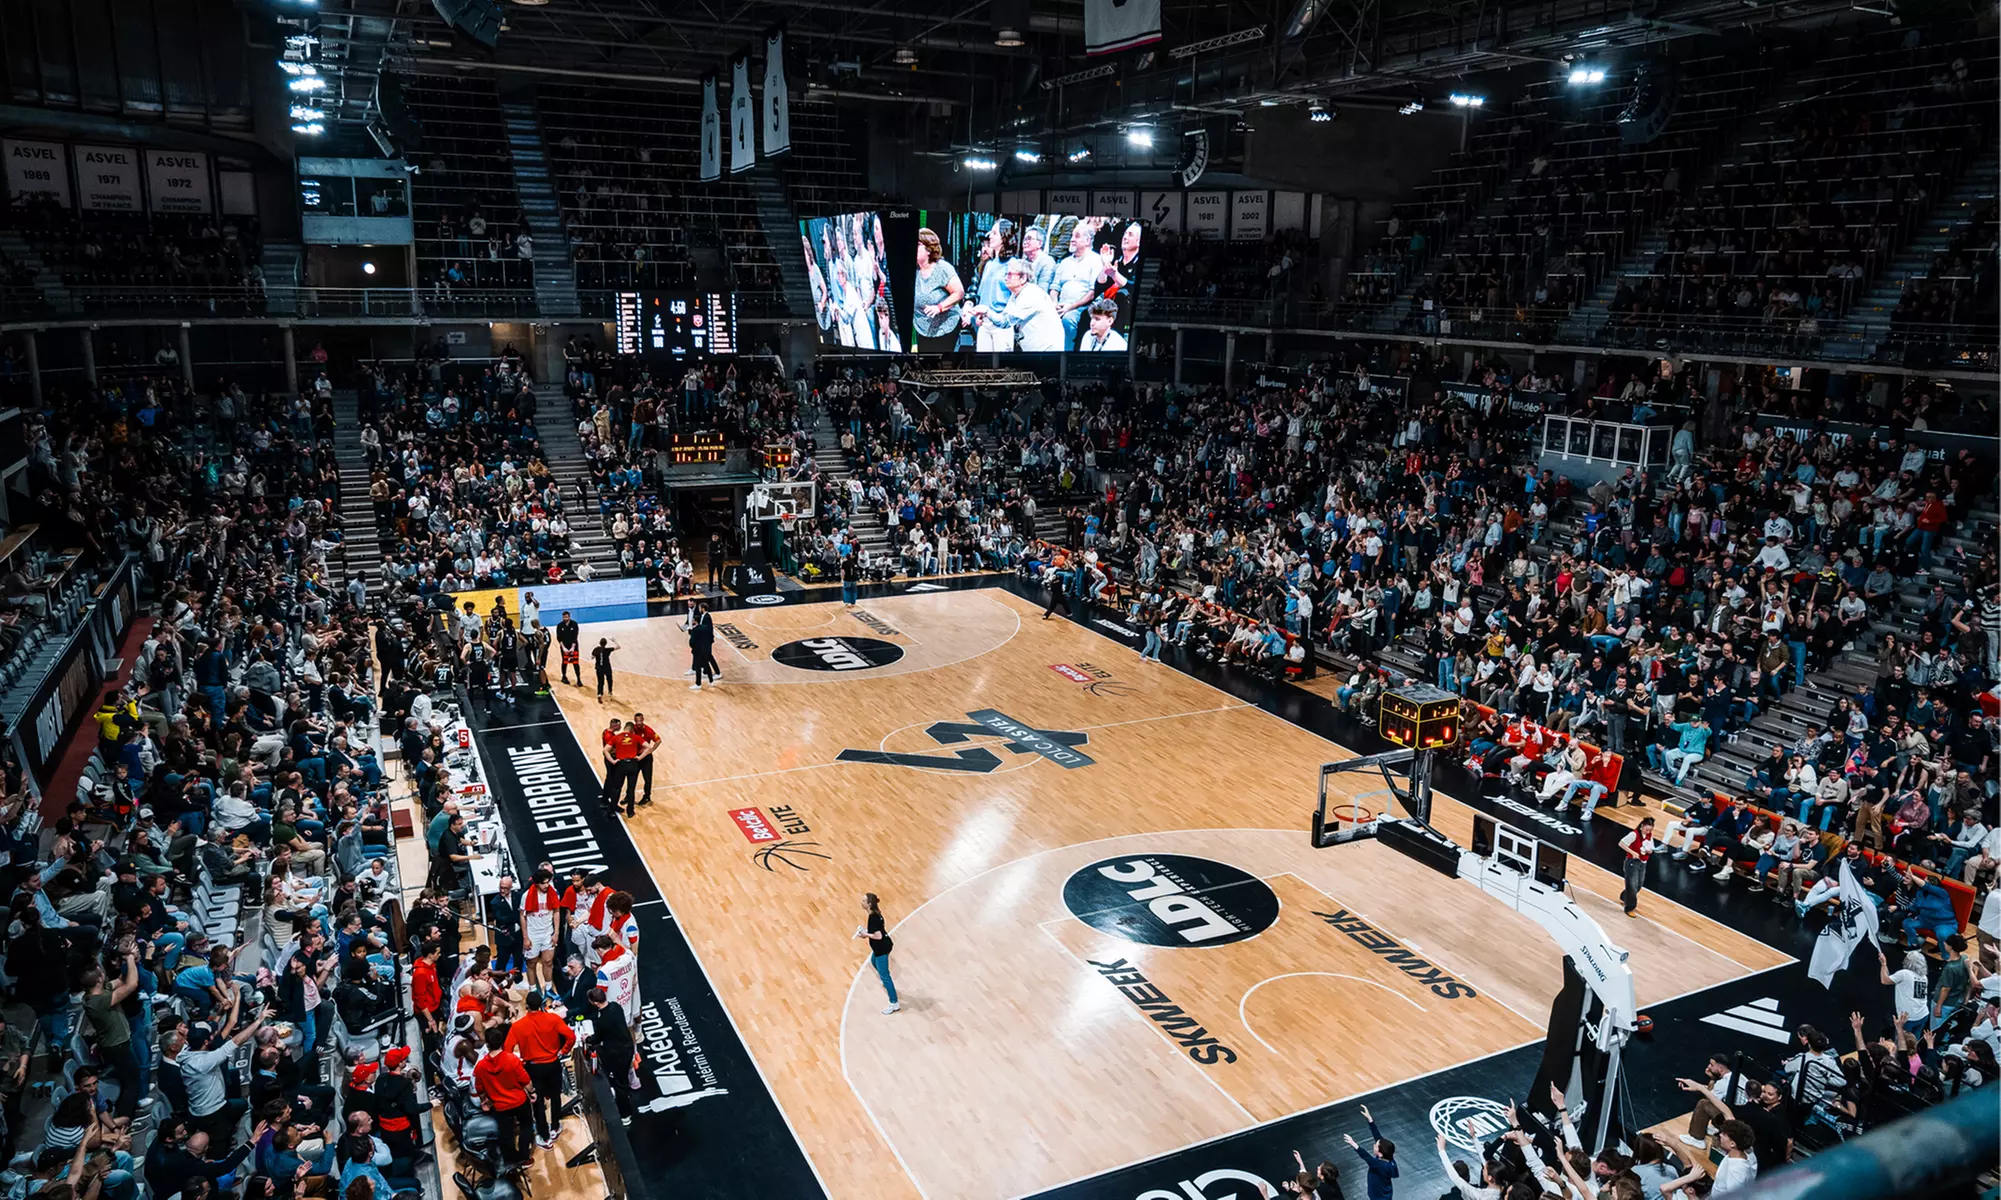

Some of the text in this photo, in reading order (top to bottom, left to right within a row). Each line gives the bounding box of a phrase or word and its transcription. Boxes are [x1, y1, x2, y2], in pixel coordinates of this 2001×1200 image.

[13, 147, 57, 160] ASVEL
[86, 152, 129, 165] ASVEL
[156, 156, 199, 169] ASVEL
[98, 175, 121, 185] 1971
[167, 178, 192, 188] 1972
[1052, 195, 1081, 204] ASVEL
[1100, 196, 1128, 205] ASVEL
[1192, 196, 1221, 205] ASVEL
[1238, 195, 1264, 204] ASVEL
[1198, 212, 1215, 220] 1981
[1242, 212, 1260, 220] 2002
[850, 610, 900, 636] SKWEEK
[714, 622, 759, 650] SKWEEK
[802, 637, 870, 670] LDLC
[438, 671, 447, 680] 21
[460, 732, 468, 742] 5
[987, 716, 1081, 764] LDLC ASVEL
[507, 743, 609, 880] VILLEURBANNE
[1483, 795, 1583, 835] SKWEEK
[1098, 860, 1240, 943] LDLC
[1145, 858, 1252, 932] HIGH-TECH EXPERIENCE
[1311, 909, 1477, 999] SKWEEK
[1580, 945, 1607, 982] SPALDING
[1086, 958, 1238, 1064] SKWEEK
[664, 996, 718, 1087] Intérim & Recrutement
